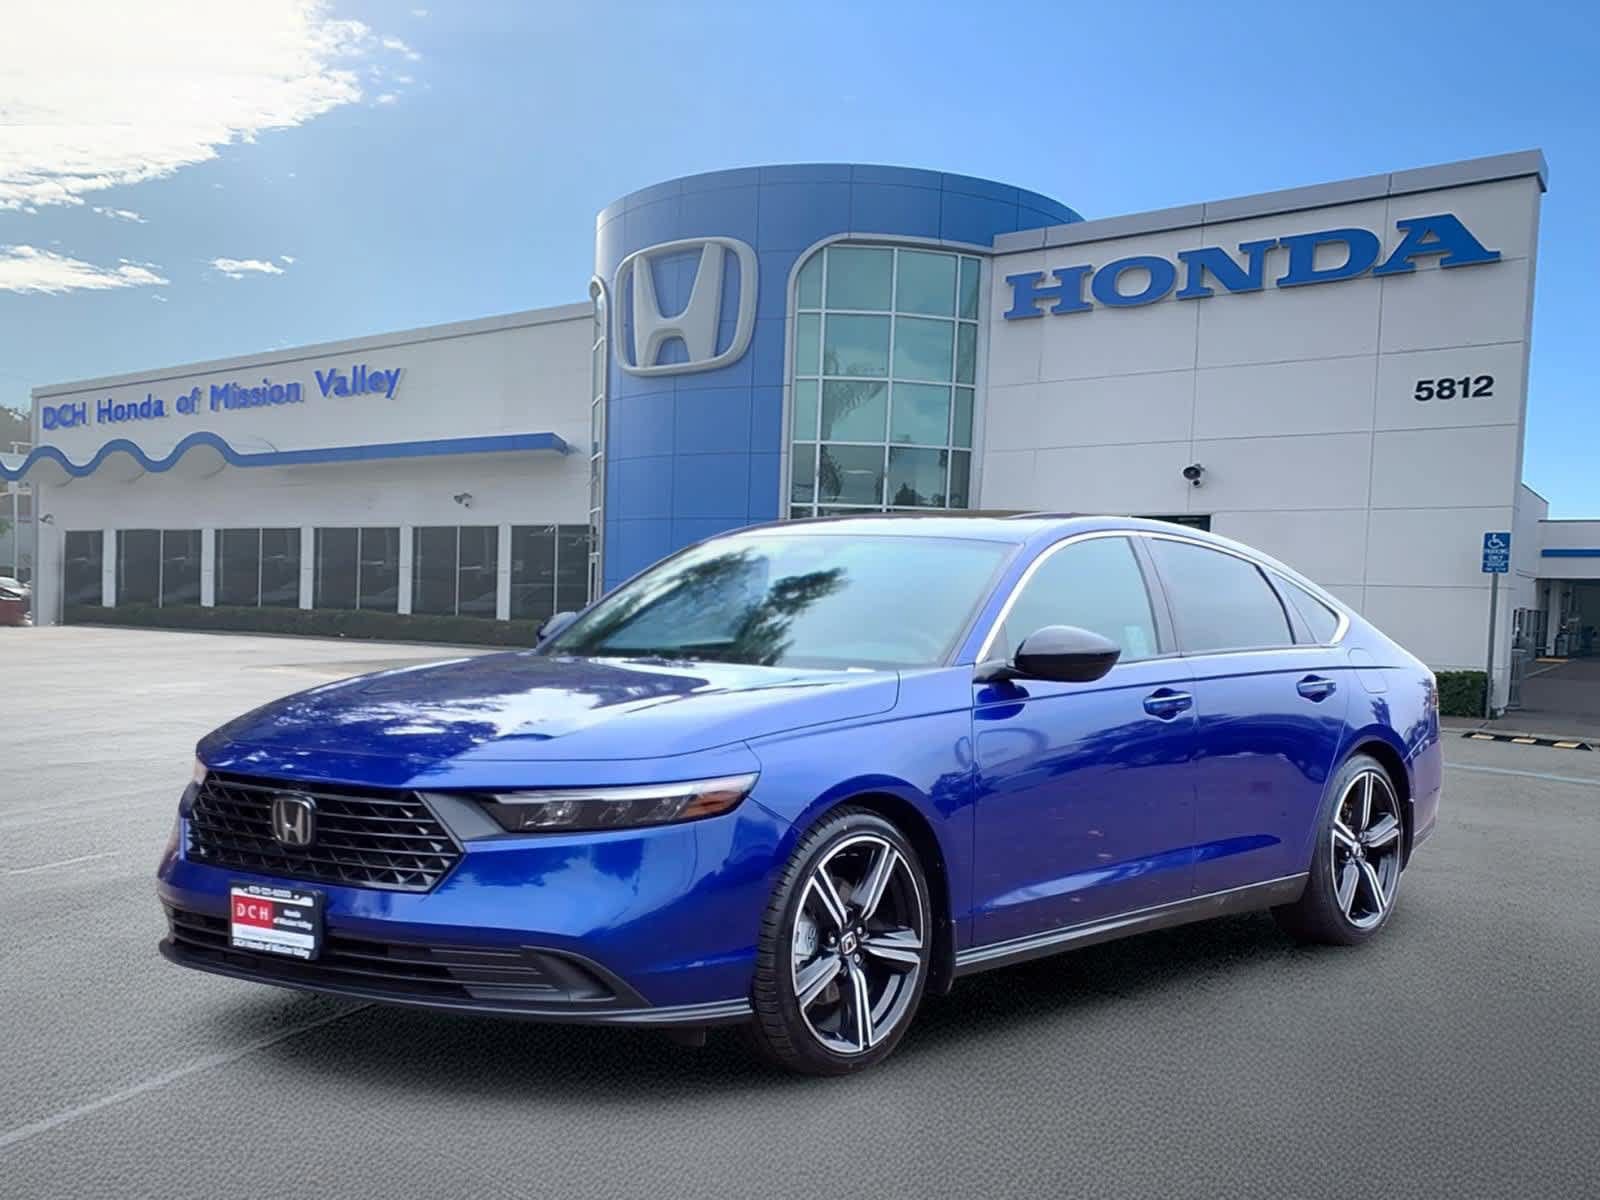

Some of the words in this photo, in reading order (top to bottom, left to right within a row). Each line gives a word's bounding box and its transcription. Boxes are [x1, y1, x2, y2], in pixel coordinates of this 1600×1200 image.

[1003, 213, 1501, 320] HONDA
[42, 401, 87, 430] DCH
[97, 393, 164, 423] Honda
[176, 387, 201, 414] of
[210, 378, 303, 411] Mission
[314, 364, 402, 400] Valley
[1413, 375, 1495, 402] 5812
[236, 903, 270, 921] DCH
